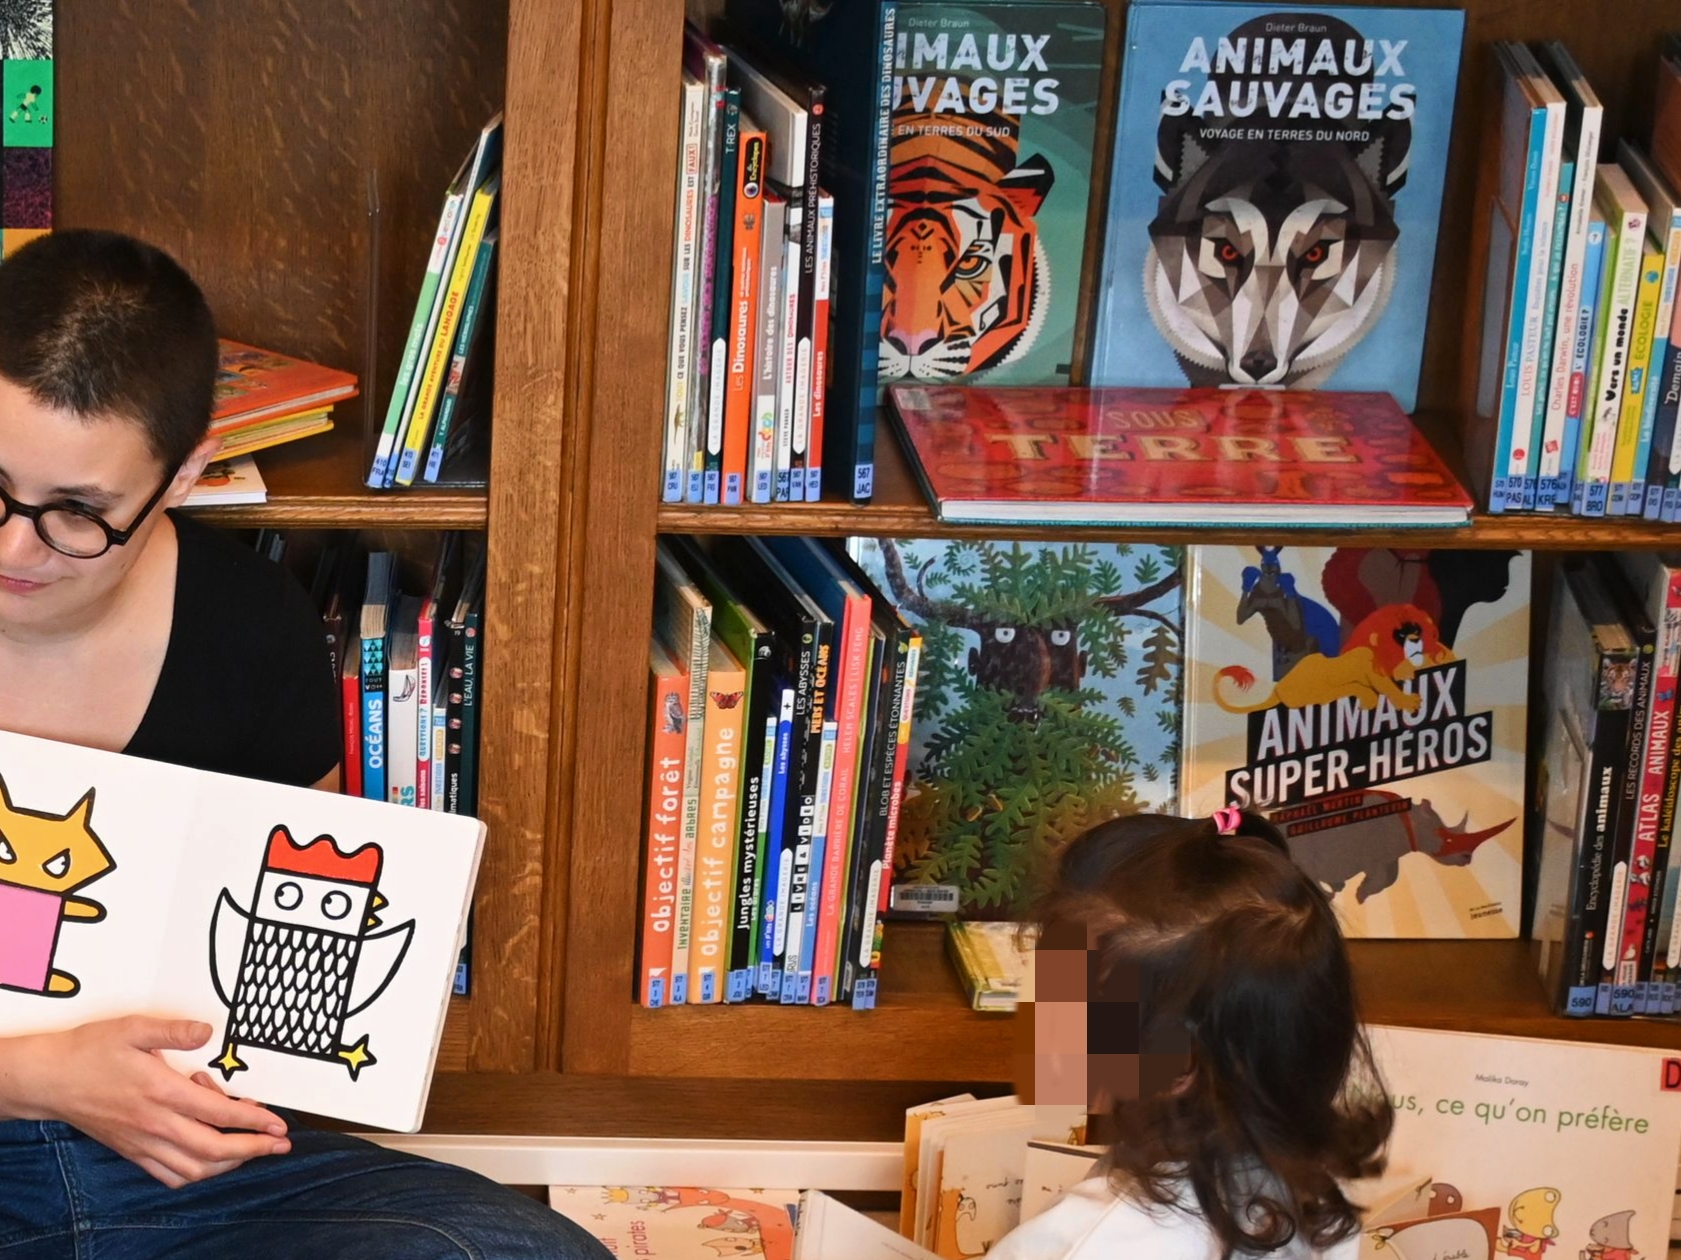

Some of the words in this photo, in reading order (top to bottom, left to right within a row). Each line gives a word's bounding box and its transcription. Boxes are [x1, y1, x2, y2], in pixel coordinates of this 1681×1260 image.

[908, 17, 938, 27] Dieter
[940, 18, 970, 28] Braun
[1267, 22, 1293, 33] Dieter
[1296, 22, 1329, 34] Braun
[882, 8, 896, 82] DINOSAURES
[895, 32, 1051, 71] IMAUX
[1178, 37, 1409, 77] ANIMAUX
[881, 85, 891, 106] DES
[892, 76, 1060, 115] VAGES
[1159, 80, 1416, 120] SAUVAGES
[898, 125, 914, 136] EN
[918, 126, 963, 136] TERRES
[966, 127, 983, 136] DU
[985, 127, 1010, 137] SUD
[1201, 126, 1243, 141] VOYAGE
[1245, 128, 1263, 141] EN
[1265, 128, 1310, 142] TERRES
[1314, 129, 1332, 142] DU
[1336, 129, 1372, 143] NORD
[808, 123, 821, 208] PRÉHISTORIQUES
[875, 108, 890, 212] EXTRAORDINAIRE
[806, 209, 816, 254] ANIMAUX
[873, 215, 885, 248] LIVRE
[805, 256, 813, 273] LES
[872, 250, 883, 264] LE
[732, 301, 749, 373] Dinosaures
[733, 375, 744, 391] Les
[1106, 408, 1201, 432] SOUS
[992, 432, 1367, 464] TERRE
[464, 663, 473, 675] LA
[465, 644, 474, 661] VIE
[463, 678, 474, 706] L'EAU,
[798, 651, 811, 695] ABYSSES
[797, 697, 807, 715] LES
[887, 661, 906, 729] ÉTONNANTES
[364, 700, 383, 768] OCÉANS
[883, 731, 898, 774] ESPÈCES
[1648, 710, 1670, 775] ANIMAUX
[1229, 715, 1491, 808] SUPER-HÉROS
[655, 757, 680, 825] forêt
[711, 727, 736, 849] campagne
[882, 776, 891, 788] ET
[1594, 767, 1613, 832] animaux
[879, 789, 891, 816] BLOB
[887, 781, 901, 829] microbes
[1637, 793, 1660, 842] ATLAS
[742, 776, 760, 873] mystérieuses
[1591, 835, 1605, 852] des
[882, 830, 894, 870] Planète
[650, 833, 675, 933] objectif
[1585, 854, 1605, 910] Encyclopédie
[698, 857, 725, 956] objectif
[736, 877, 752, 929] Jungles
[1475, 1073, 1502, 1084] Malika
[1504, 1076, 1529, 1088] Doray
[1665, 1059, 1681, 1089] D
[1436, 1098, 1464, 1115] ce
[1474, 1098, 1546, 1125] qu'on
[1557, 1105, 1649, 1134] préfère
[628, 1220, 657, 1256] pirates
